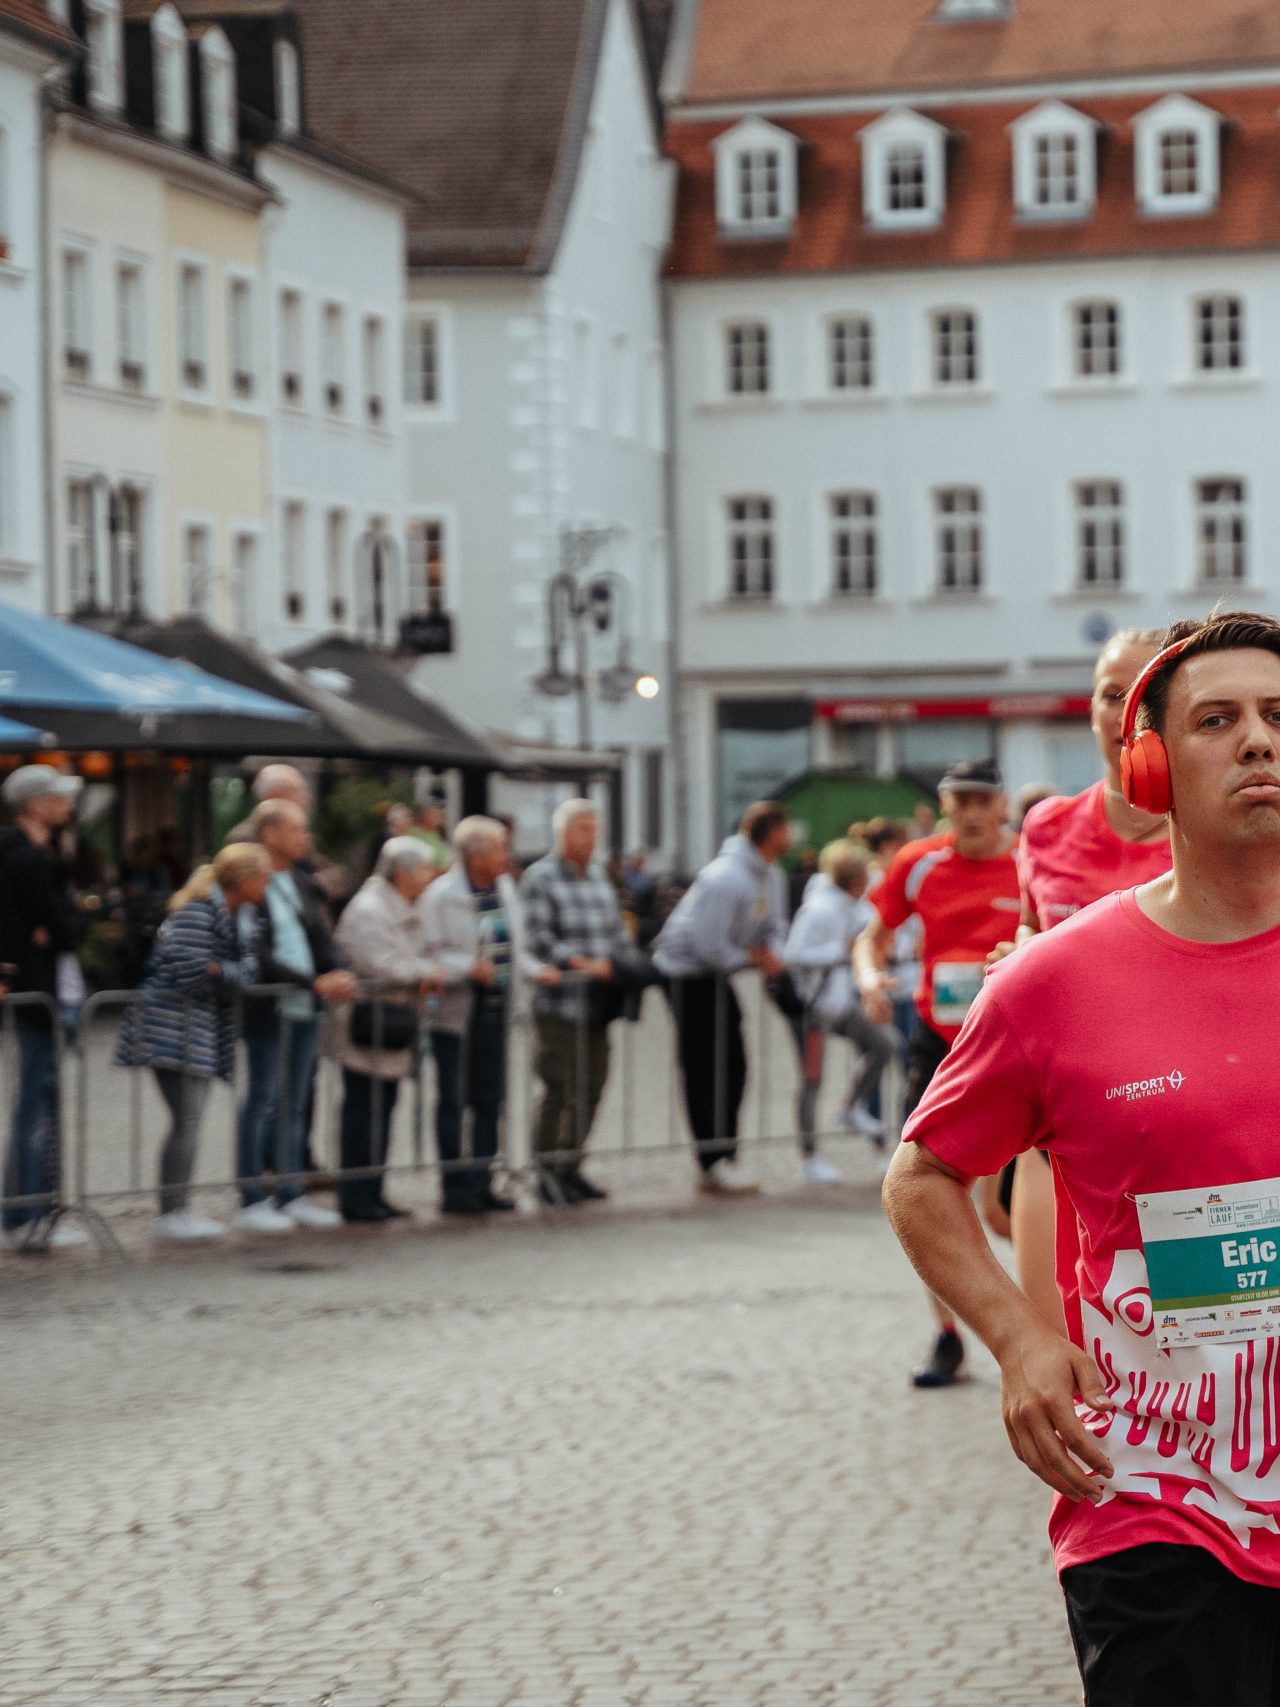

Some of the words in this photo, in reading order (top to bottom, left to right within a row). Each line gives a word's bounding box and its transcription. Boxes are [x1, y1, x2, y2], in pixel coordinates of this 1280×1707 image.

[1106, 1077, 1165, 1099] UNISPORT
[1126, 1087, 1165, 1101] ZENTRUM
[1209, 1193, 1220, 1201] dm
[1209, 1206, 1232, 1214] FIRMEN
[1210, 1213, 1233, 1224] LAUF
[1221, 1237, 1277, 1267] Eric
[1237, 1270, 1267, 1288] 577
[1163, 1315, 1176, 1324] dm
